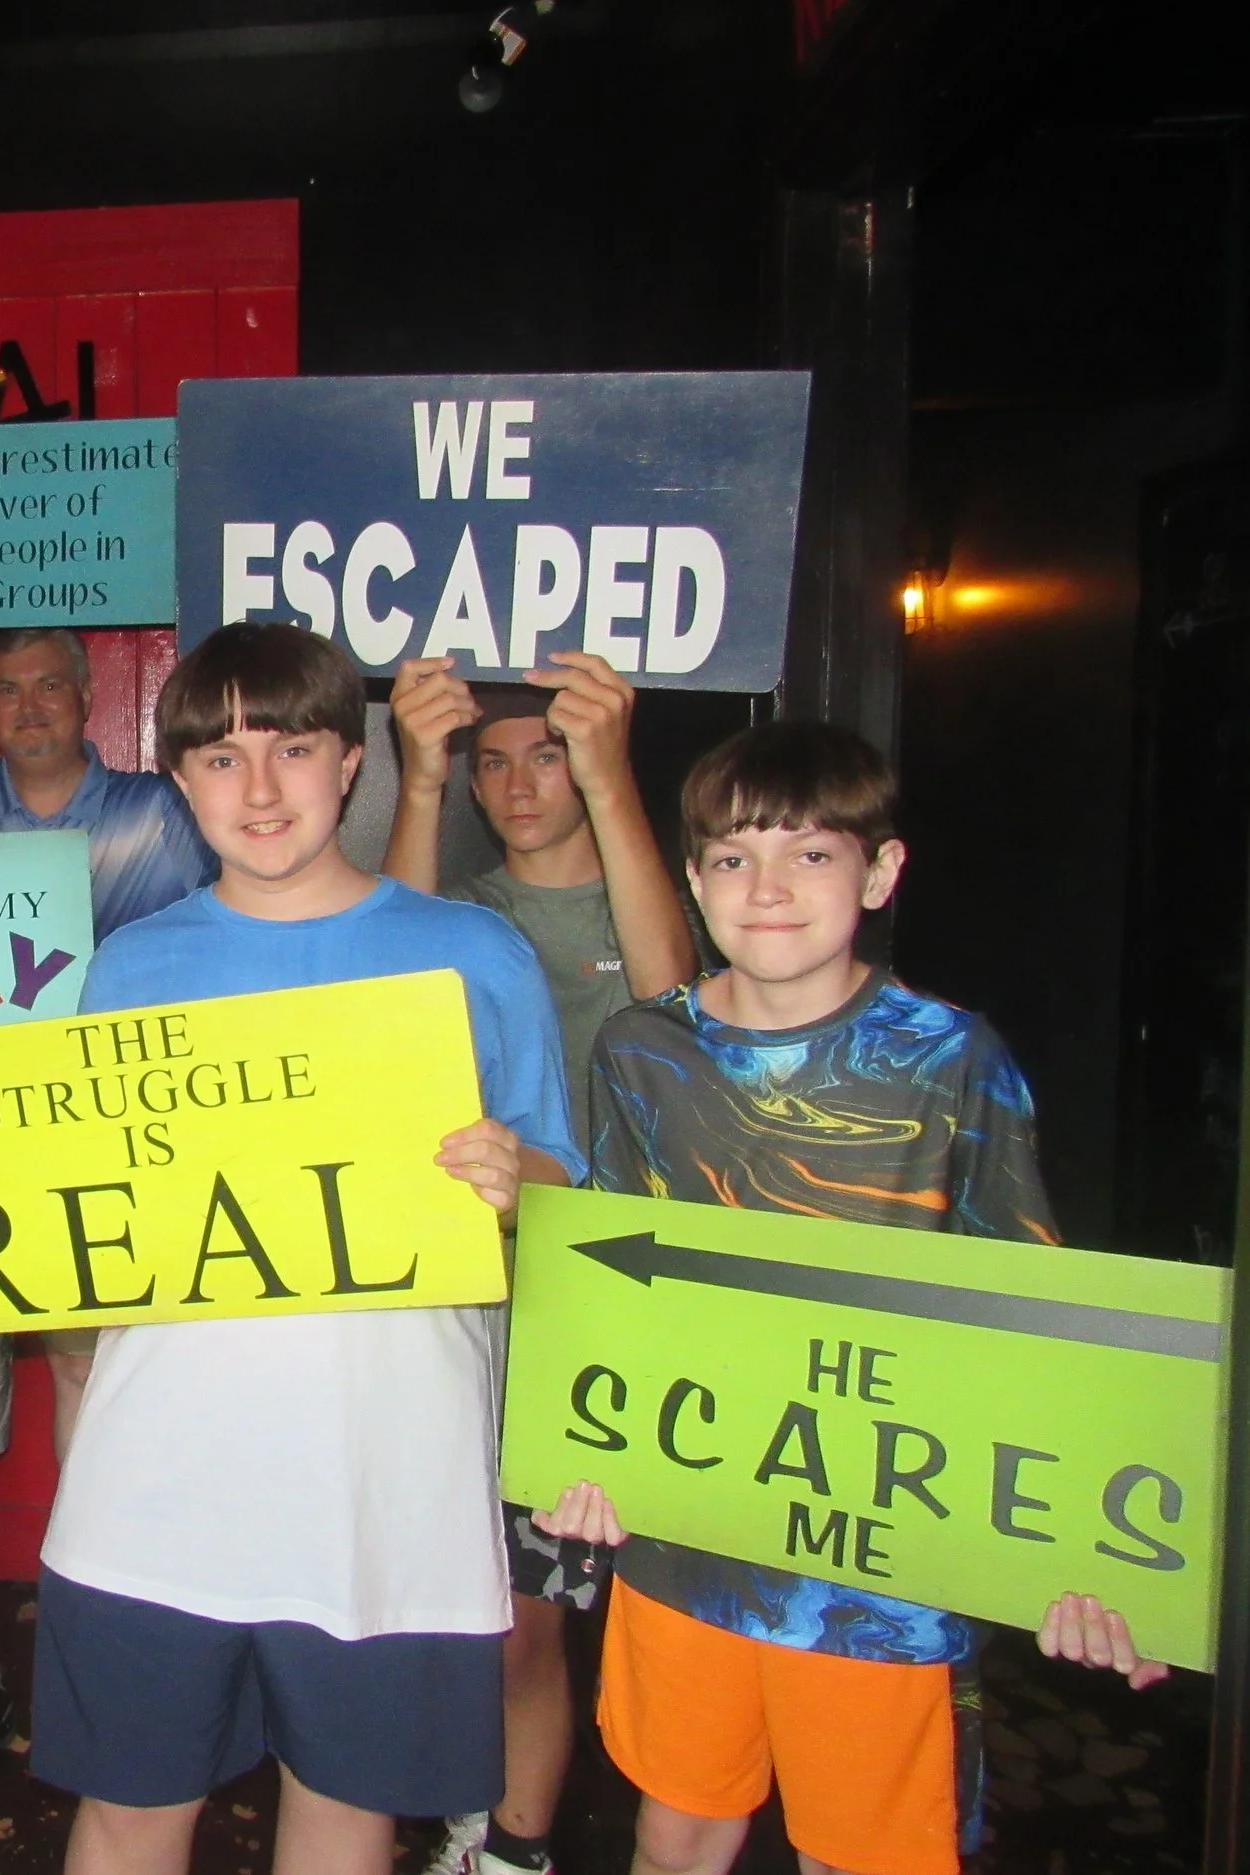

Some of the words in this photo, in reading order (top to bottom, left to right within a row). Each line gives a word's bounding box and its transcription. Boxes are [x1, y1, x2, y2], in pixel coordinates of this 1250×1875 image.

[412, 400, 535, 500] WE
[66, 484, 106, 518] of
[95, 531, 126, 562] in
[222, 520, 726, 674] ESCAPED
[65, 1013, 196, 1070] THE
[119, 1121, 176, 1170] IS
[807, 1337, 898, 1406] HE
[564, 1363, 1187, 1572] SCARES
[785, 1501, 894, 1578] ME
